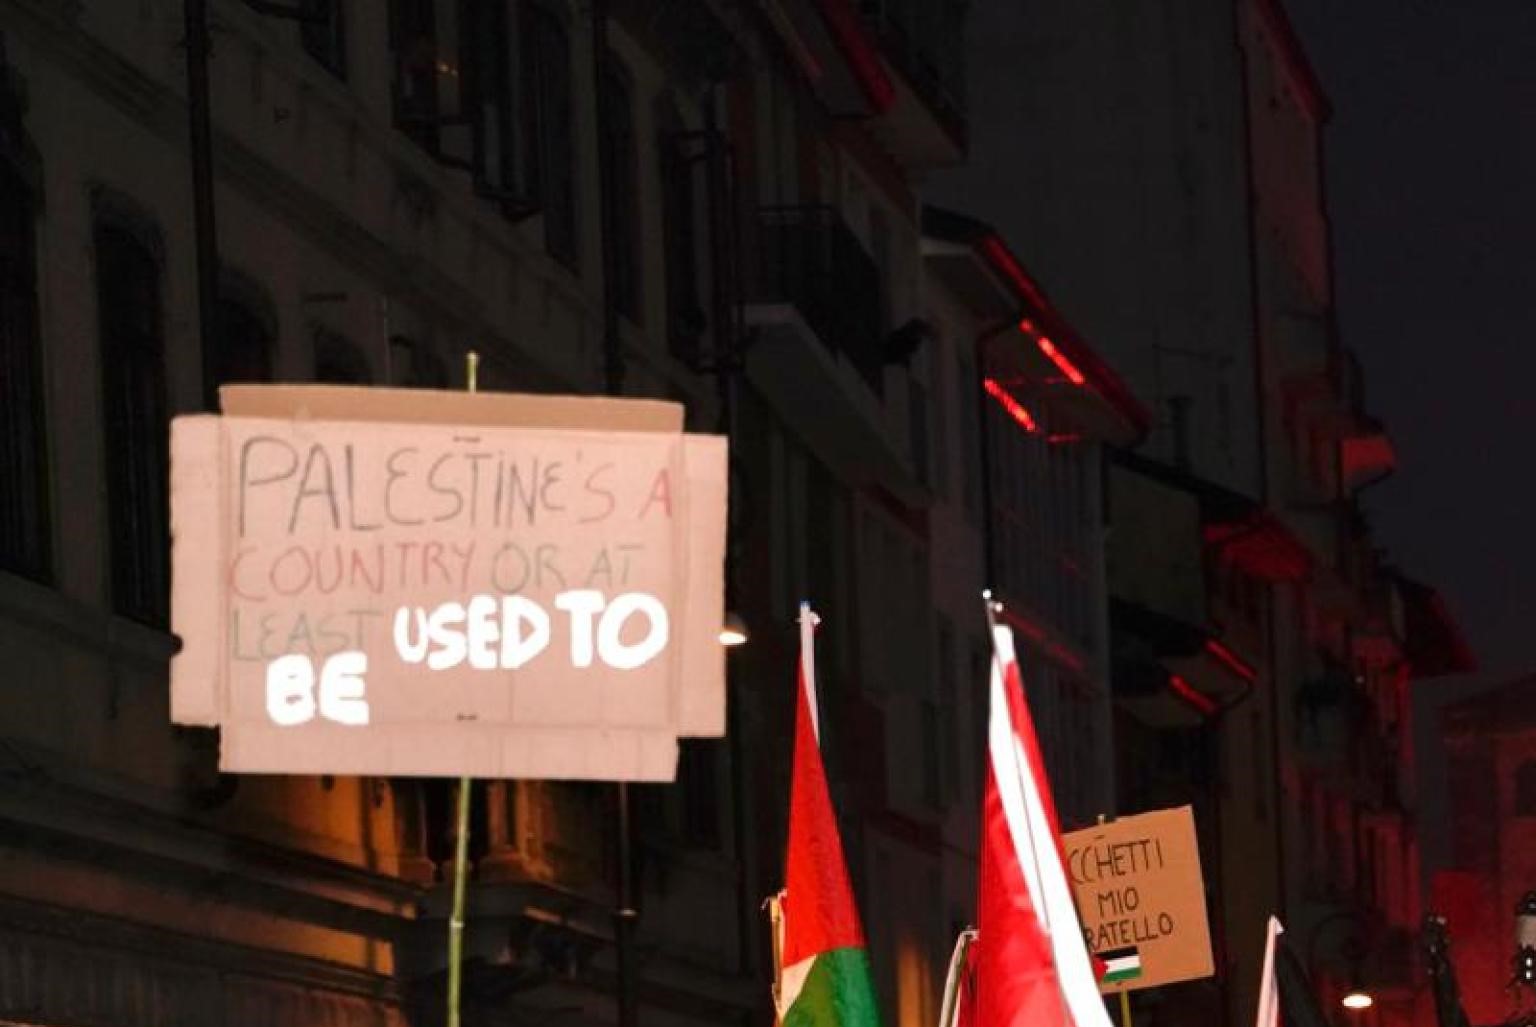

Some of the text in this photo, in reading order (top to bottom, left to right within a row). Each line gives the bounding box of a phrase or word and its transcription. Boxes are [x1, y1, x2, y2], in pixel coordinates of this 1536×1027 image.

[239, 435, 674, 537] PALESTINE'S A
[228, 540, 643, 601] COUNTRY OR AT
[231, 590, 669, 670] LEAST USED TO
[267, 651, 369, 725] BE
[1097, 886, 1140, 918] MIO
